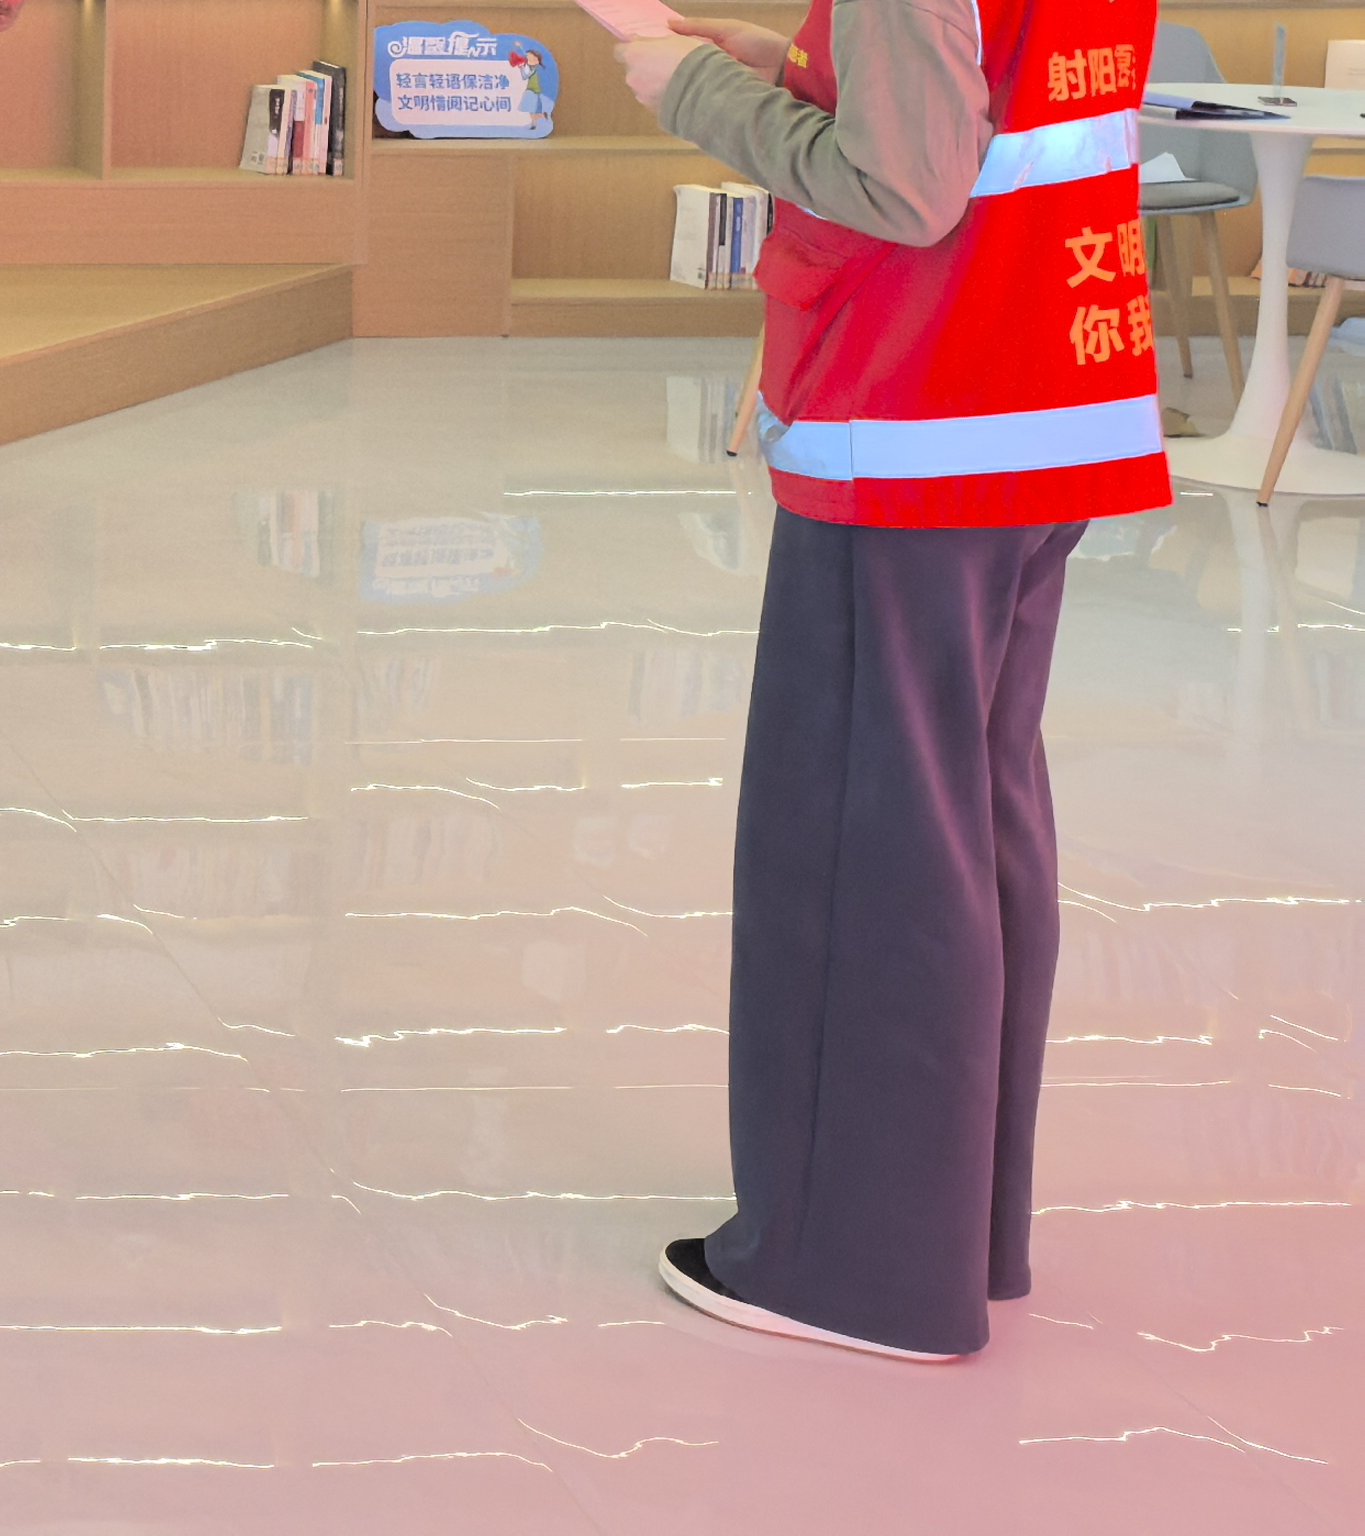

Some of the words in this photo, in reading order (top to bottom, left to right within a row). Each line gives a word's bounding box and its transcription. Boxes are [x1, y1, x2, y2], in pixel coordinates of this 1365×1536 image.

[387, 31, 497, 58] 温馨提示
[396, 72, 510, 91] 轻言轻语保洁净
